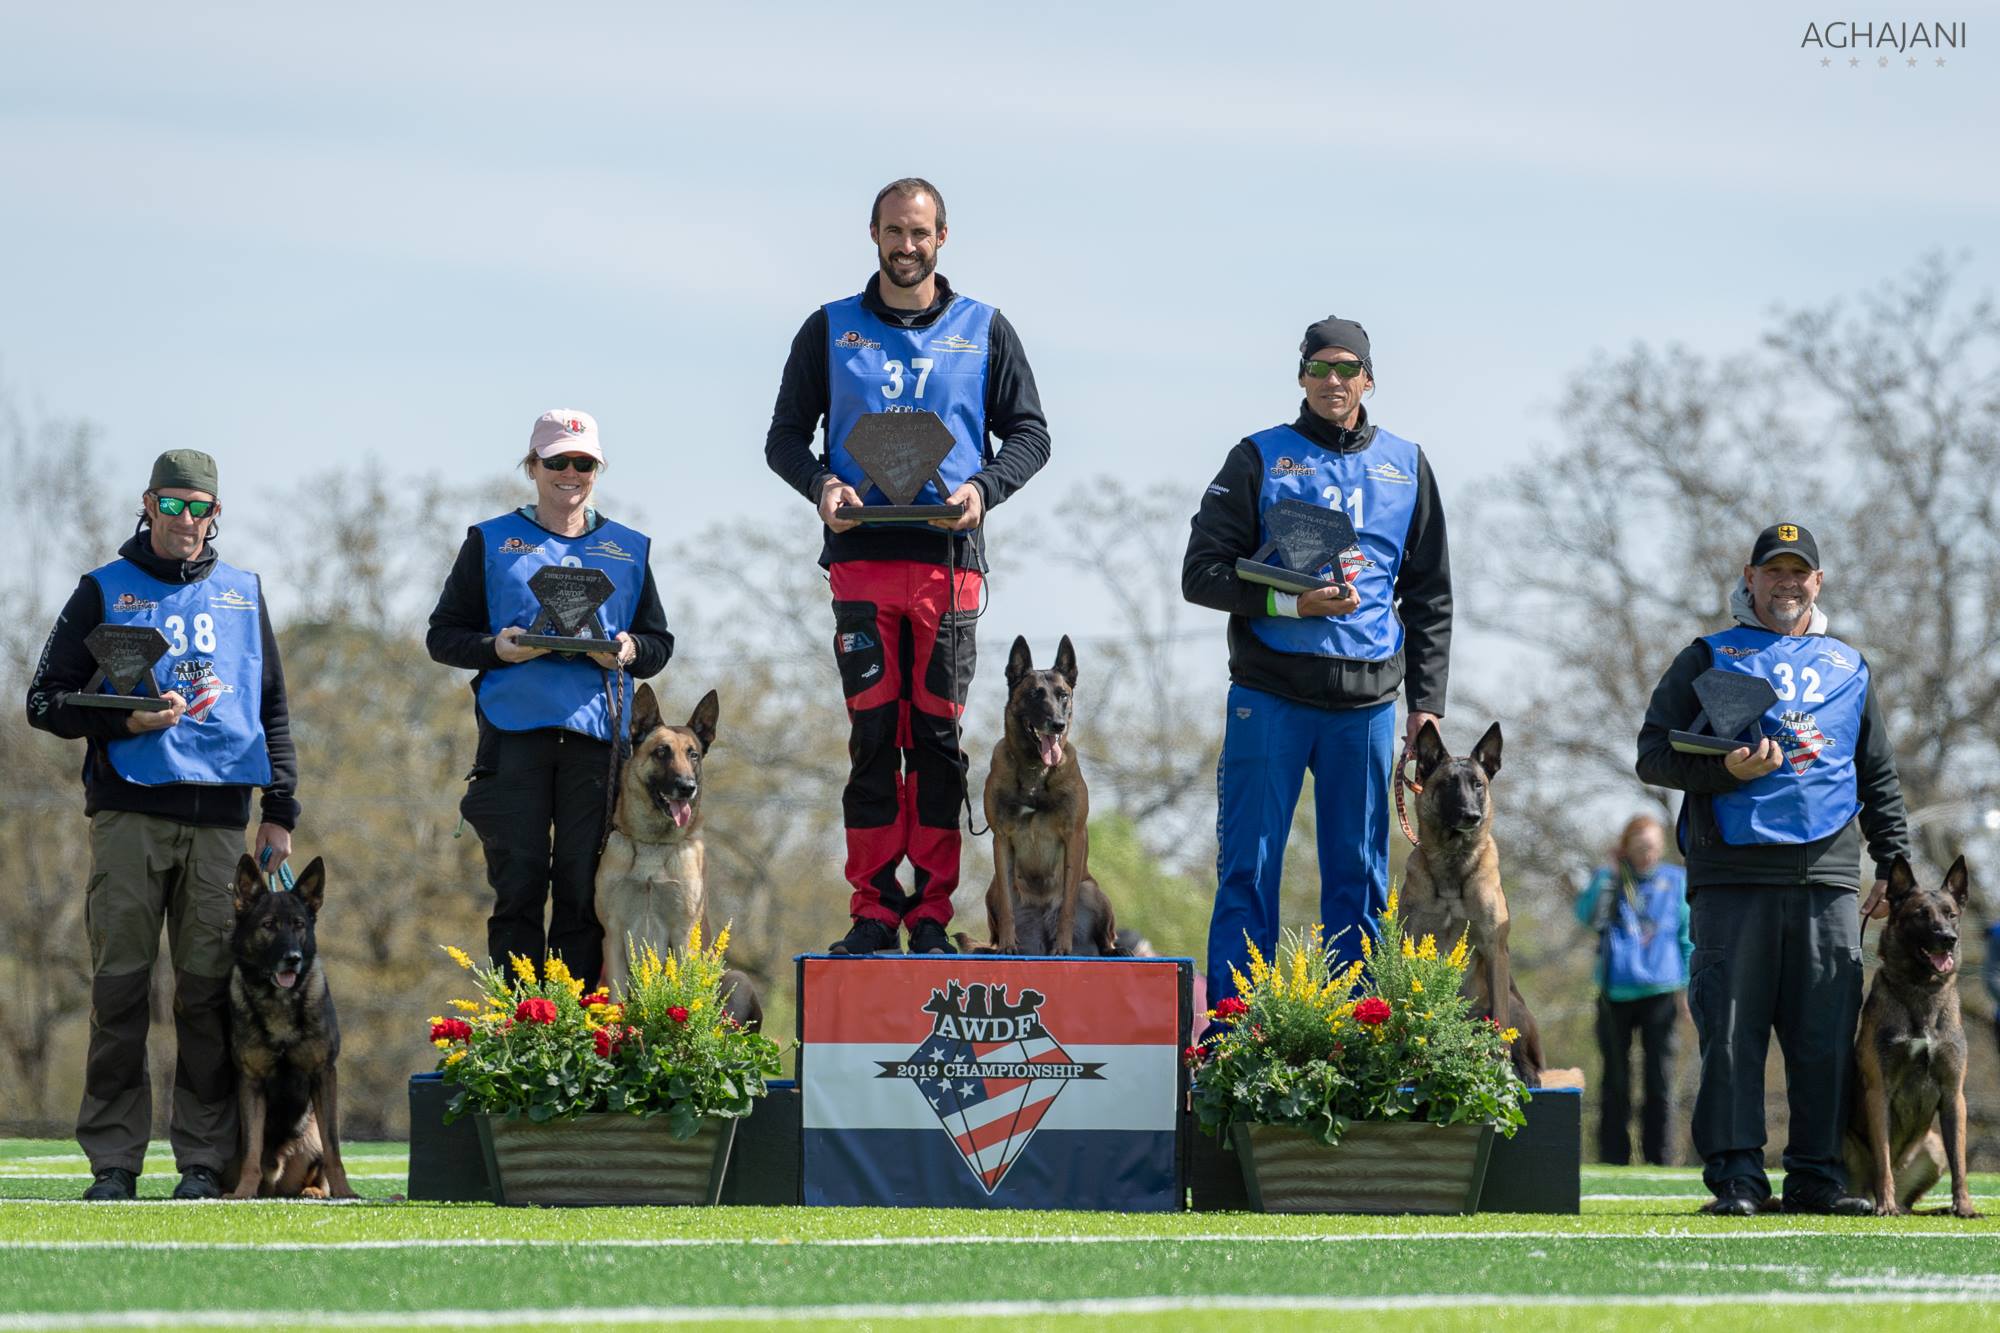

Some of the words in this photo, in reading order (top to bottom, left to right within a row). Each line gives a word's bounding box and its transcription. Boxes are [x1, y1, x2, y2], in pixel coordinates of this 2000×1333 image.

[881, 357, 934, 400] 37
[1323, 485, 1363, 528] 31
[165, 613, 217, 657] 38
[179, 668, 213, 681] AWDF
[1773, 662, 1825, 703] 32
[936, 1013, 1037, 1042] AWDF
[897, 1064, 938, 1077] 2019
[943, 1063, 1084, 1078] CHAMPIONSHIP
